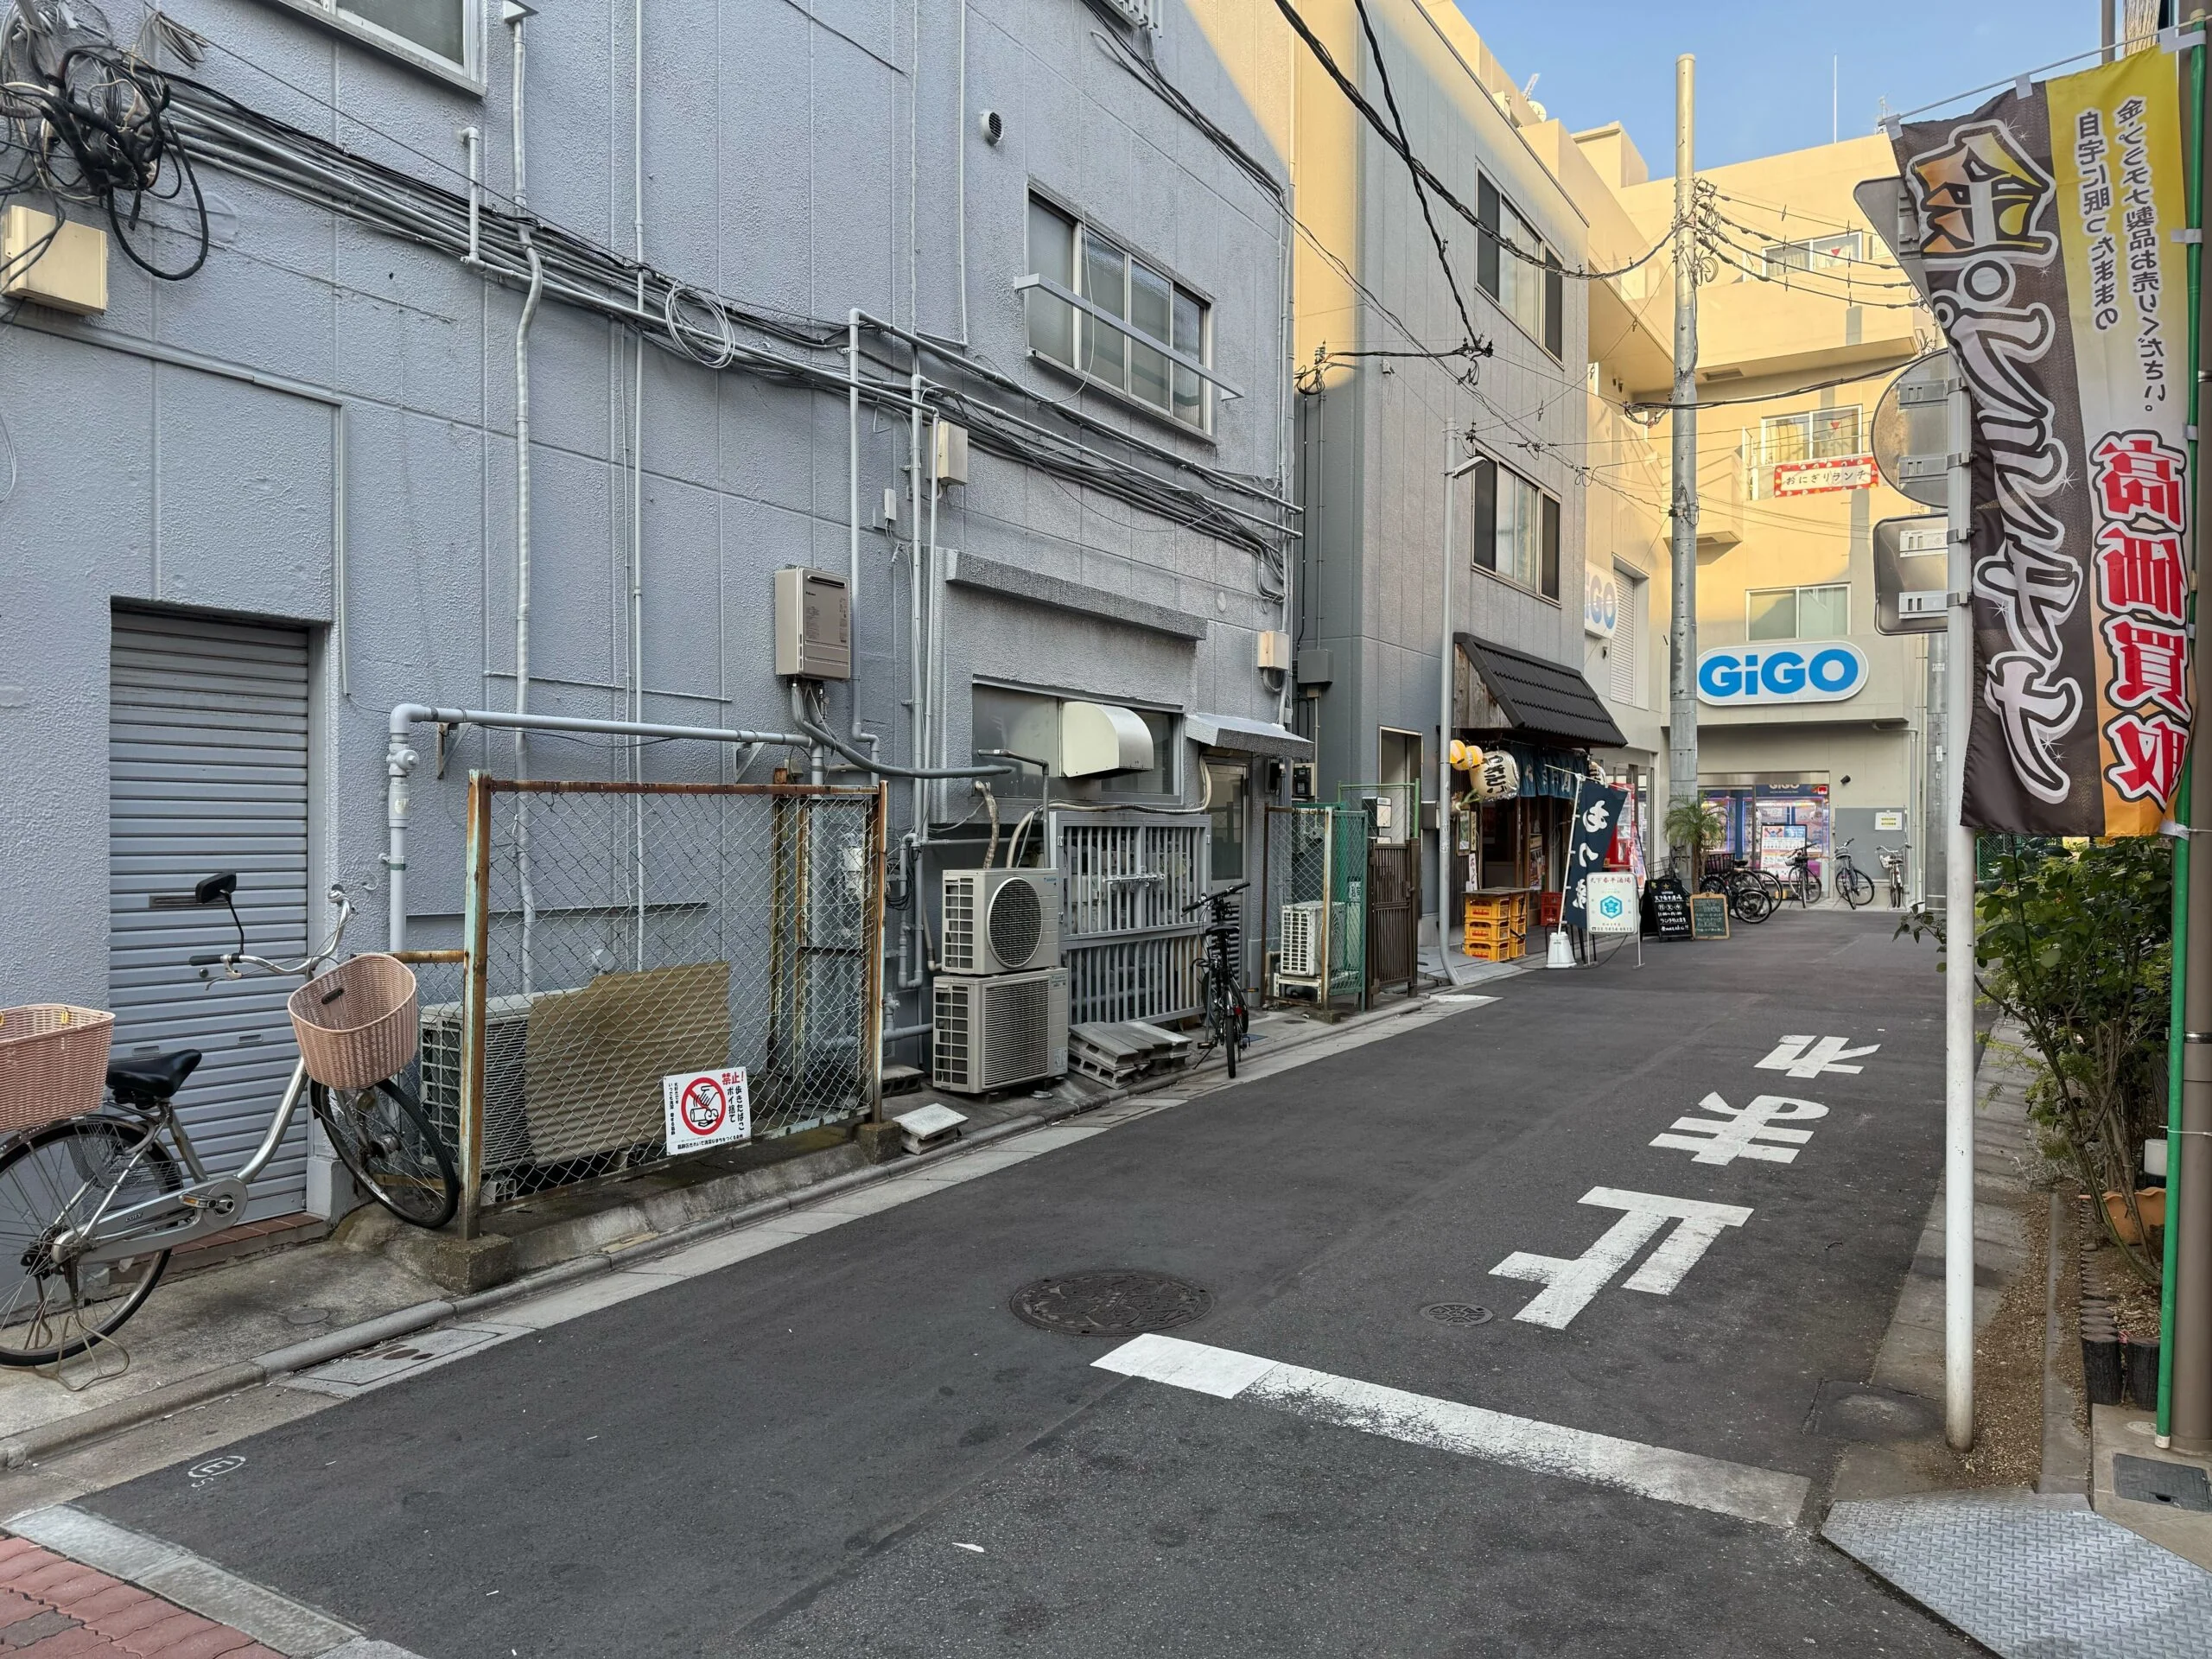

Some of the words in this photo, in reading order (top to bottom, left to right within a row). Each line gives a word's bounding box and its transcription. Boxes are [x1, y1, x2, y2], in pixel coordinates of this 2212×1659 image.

[1786, 469, 1866, 486] おにぎりランチ
[1586, 571, 1616, 630] iGO
[1699, 649, 1859, 697] GiGO
[727, 1086, 736, 1123] ポイ捨て
[734, 1085, 745, 1131] 歩きたばこ
[1488, 1035, 1881, 1331] 止まれ
